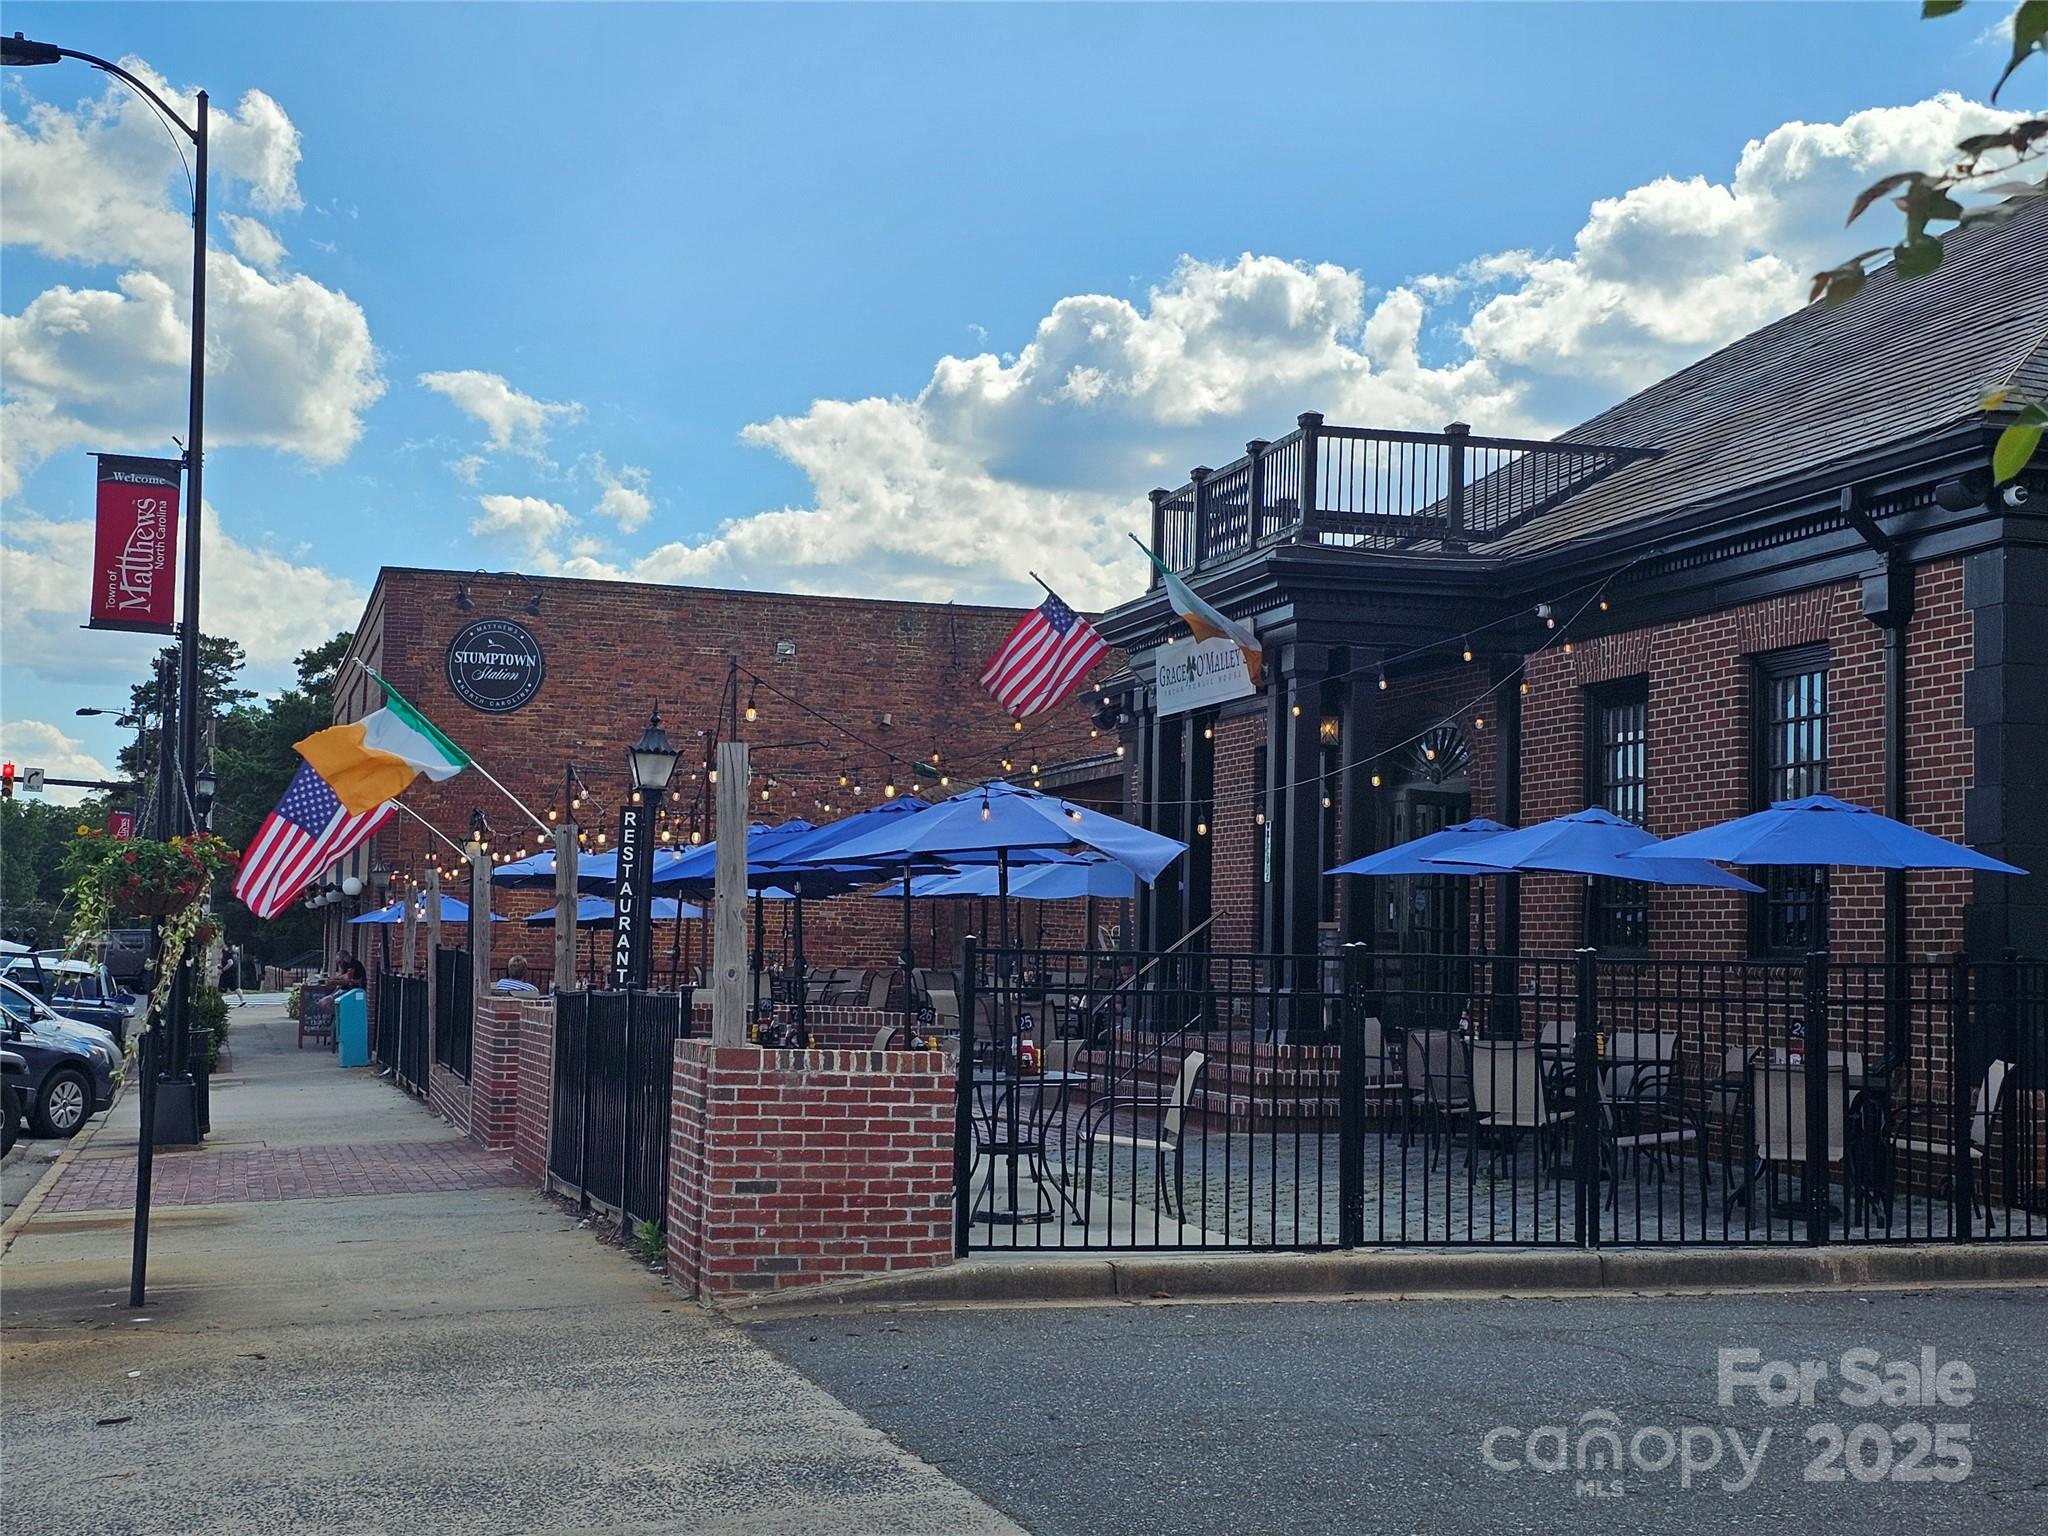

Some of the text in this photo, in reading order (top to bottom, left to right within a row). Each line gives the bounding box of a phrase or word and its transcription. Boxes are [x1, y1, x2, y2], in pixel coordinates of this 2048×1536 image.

[113, 472, 166, 485] Welcome
[155, 500, 168, 570] North Carolina
[116, 498, 157, 613] Matthews
[106, 570, 118, 609] Town of
[454, 651, 536, 667] STUMPTOWN
[471, 665, 519, 681] Station
[1159, 664, 1187, 688] GRACE
[460, 684, 530, 706] NORTH CAROLINA
[616, 811, 637, 983] RESTAURANT
[920, 1008, 934, 1021] 26
[1020, 1015, 1033, 1030] 25
